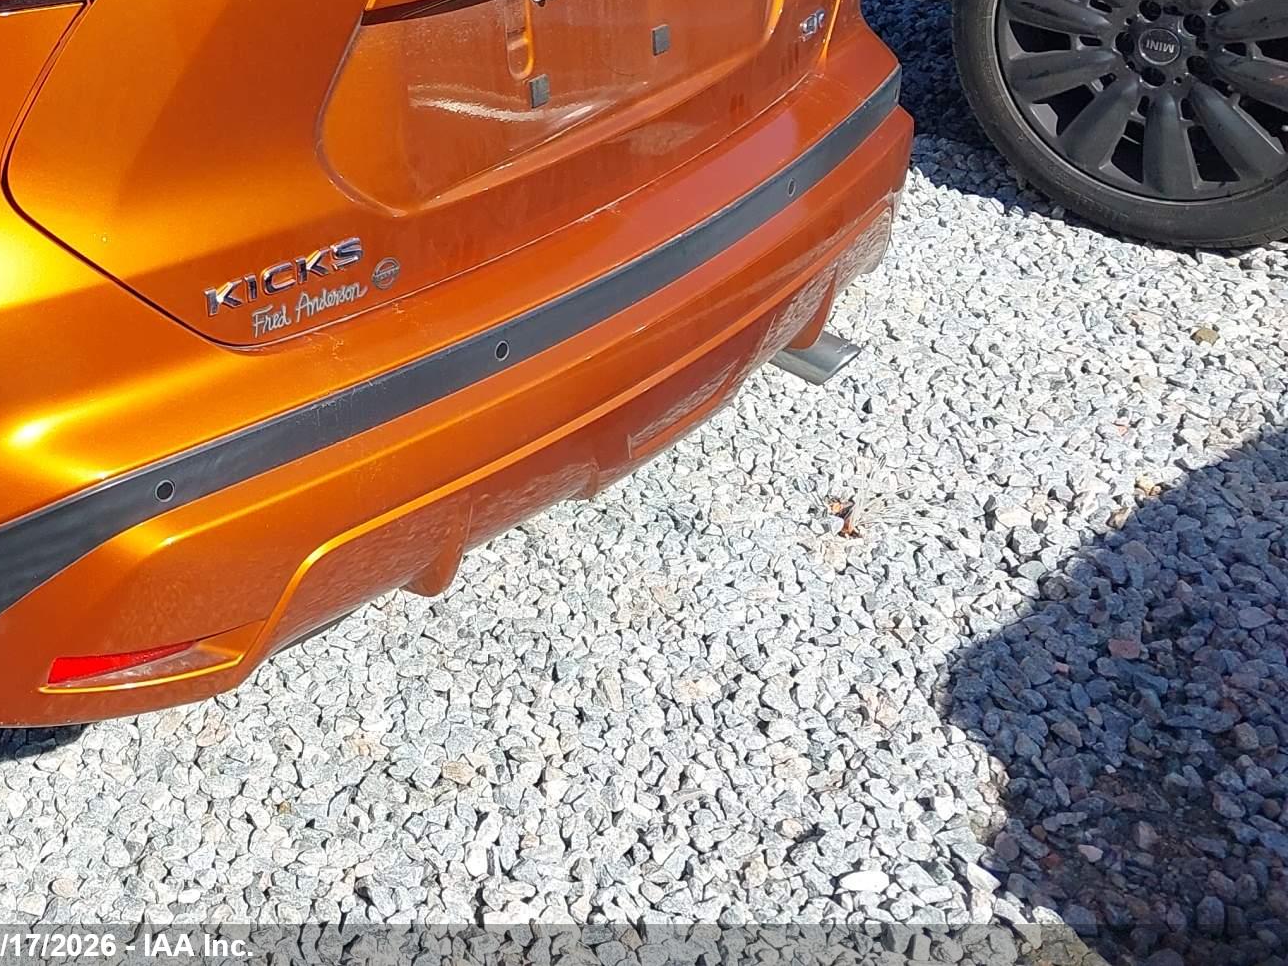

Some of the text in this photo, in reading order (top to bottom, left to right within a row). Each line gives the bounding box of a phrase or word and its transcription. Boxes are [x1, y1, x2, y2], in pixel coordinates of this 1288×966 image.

[1145, 39, 1175, 53] MINI
[204, 237, 363, 316] KICKS
[251, 282, 368, 338] Fred Anderson
